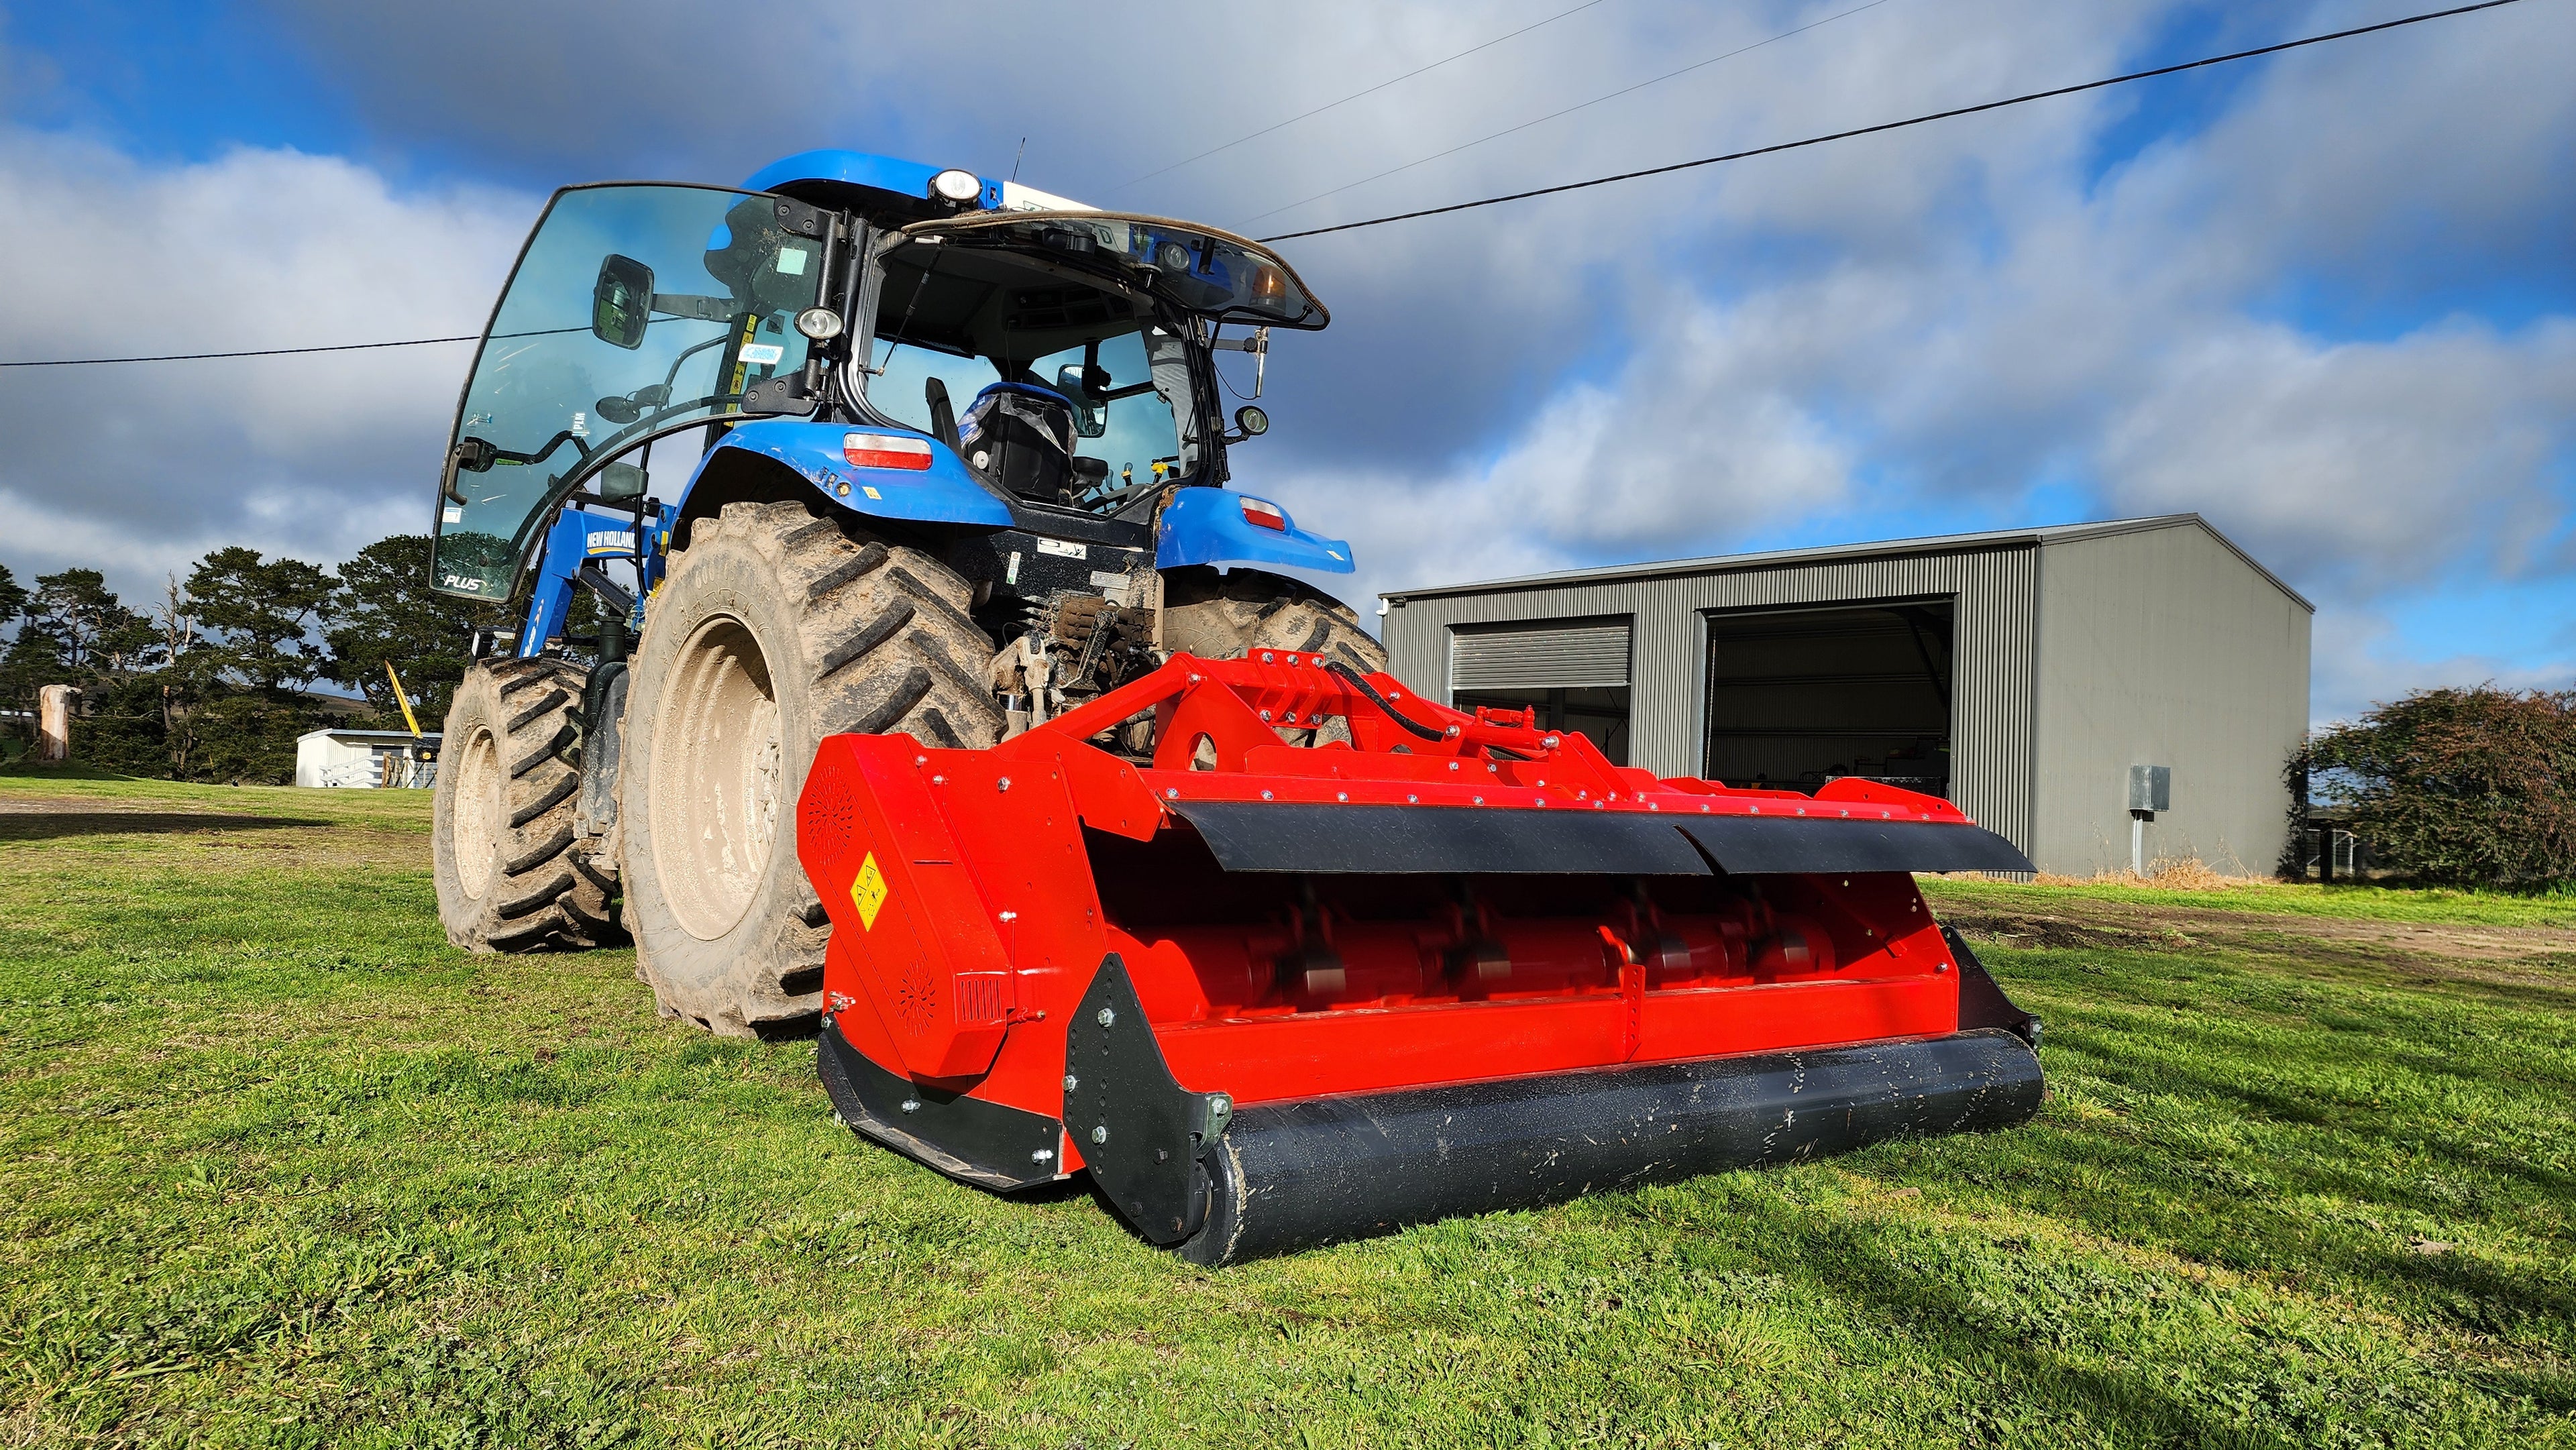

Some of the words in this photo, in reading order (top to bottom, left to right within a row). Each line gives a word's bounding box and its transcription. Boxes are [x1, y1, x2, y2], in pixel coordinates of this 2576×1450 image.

[573, 412, 586, 429] PLM
[587, 531, 604, 548] NEW
[443, 575, 482, 590] PLUS
